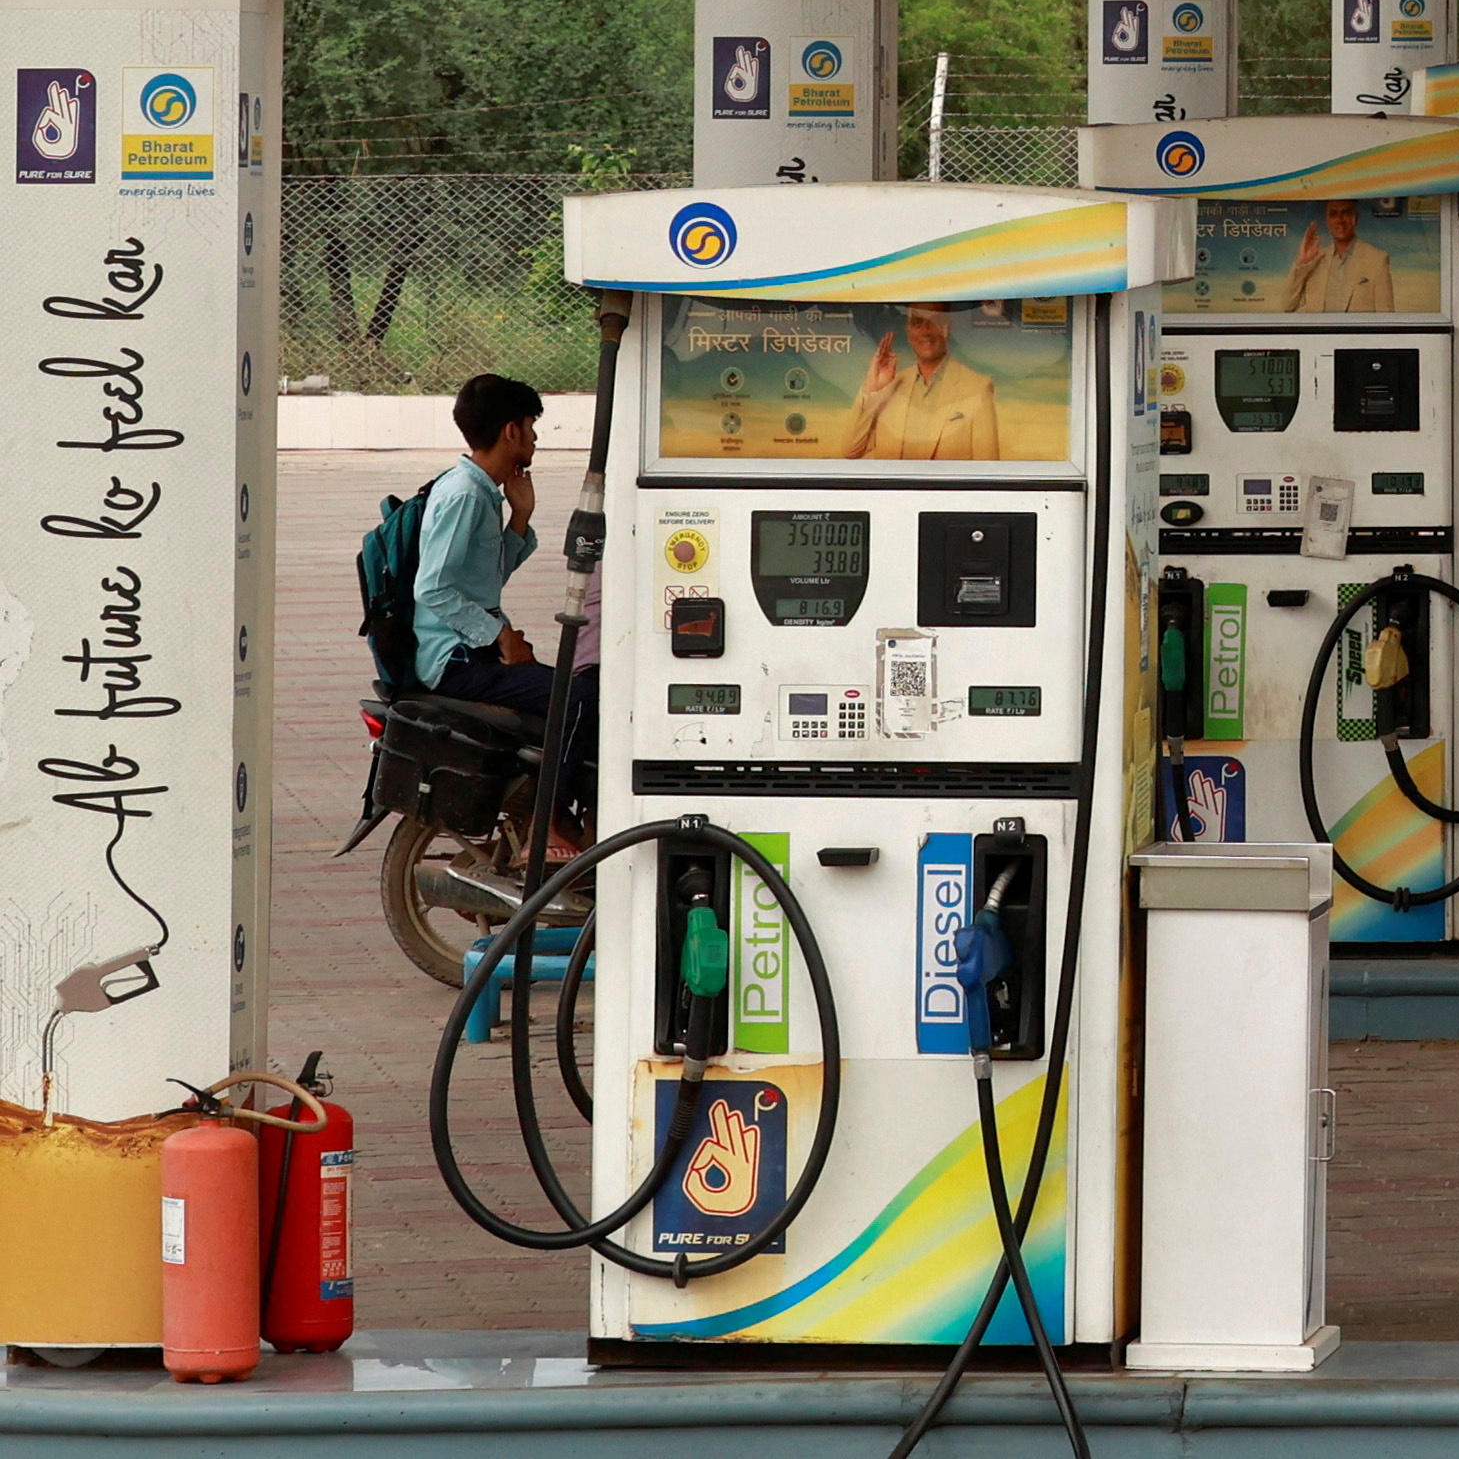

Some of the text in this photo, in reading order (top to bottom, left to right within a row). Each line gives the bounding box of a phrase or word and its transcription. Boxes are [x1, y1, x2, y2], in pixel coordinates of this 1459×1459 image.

[1172, 39, 1203, 48] Bharat
[1165, 47, 1210, 55] Petroleum
[1356, 66, 1411, 106] kar
[803, 88, 840, 98] Bharat
[793, 98, 850, 107] Petroleum
[787, 120, 856, 132] energising lives
[142, 141, 193, 153] Bharat
[128, 153, 208, 165] Petroleum
[19, 170, 45, 180] PURE
[64, 170, 93, 180] SURE
[119, 183, 215, 200] energising lives
[718, 305, 823, 324] आपकी गाड़ी का
[687, 326, 852, 354] मिस्टर डिपेंडेबल
[1251, 357, 1293, 375] 510.00
[792, 513, 822, 521] AMOUNT
[37, 236, 185, 822] Ab future ko feel kar
[787, 523, 861, 547] 3500.00
[668, 531, 706, 553] EMERGENCY
[676, 561, 698, 571] STOP
[790, 577, 830, 585] VOLUME Ltr
[783, 618, 814, 626] DENSITY
[1210, 608, 1240, 715] Petrol
[1345, 628, 1367, 686] Speed
[684, 704, 703, 713] RATE
[984, 706, 1003, 715] RATE
[681, 819, 699, 829] N 1
[996, 821, 1016, 832] N 2
[924, 868, 964, 1018] Diesel
[658, 1233, 704, 1244] PURE
[706, 1235, 732, 1244] FOR
